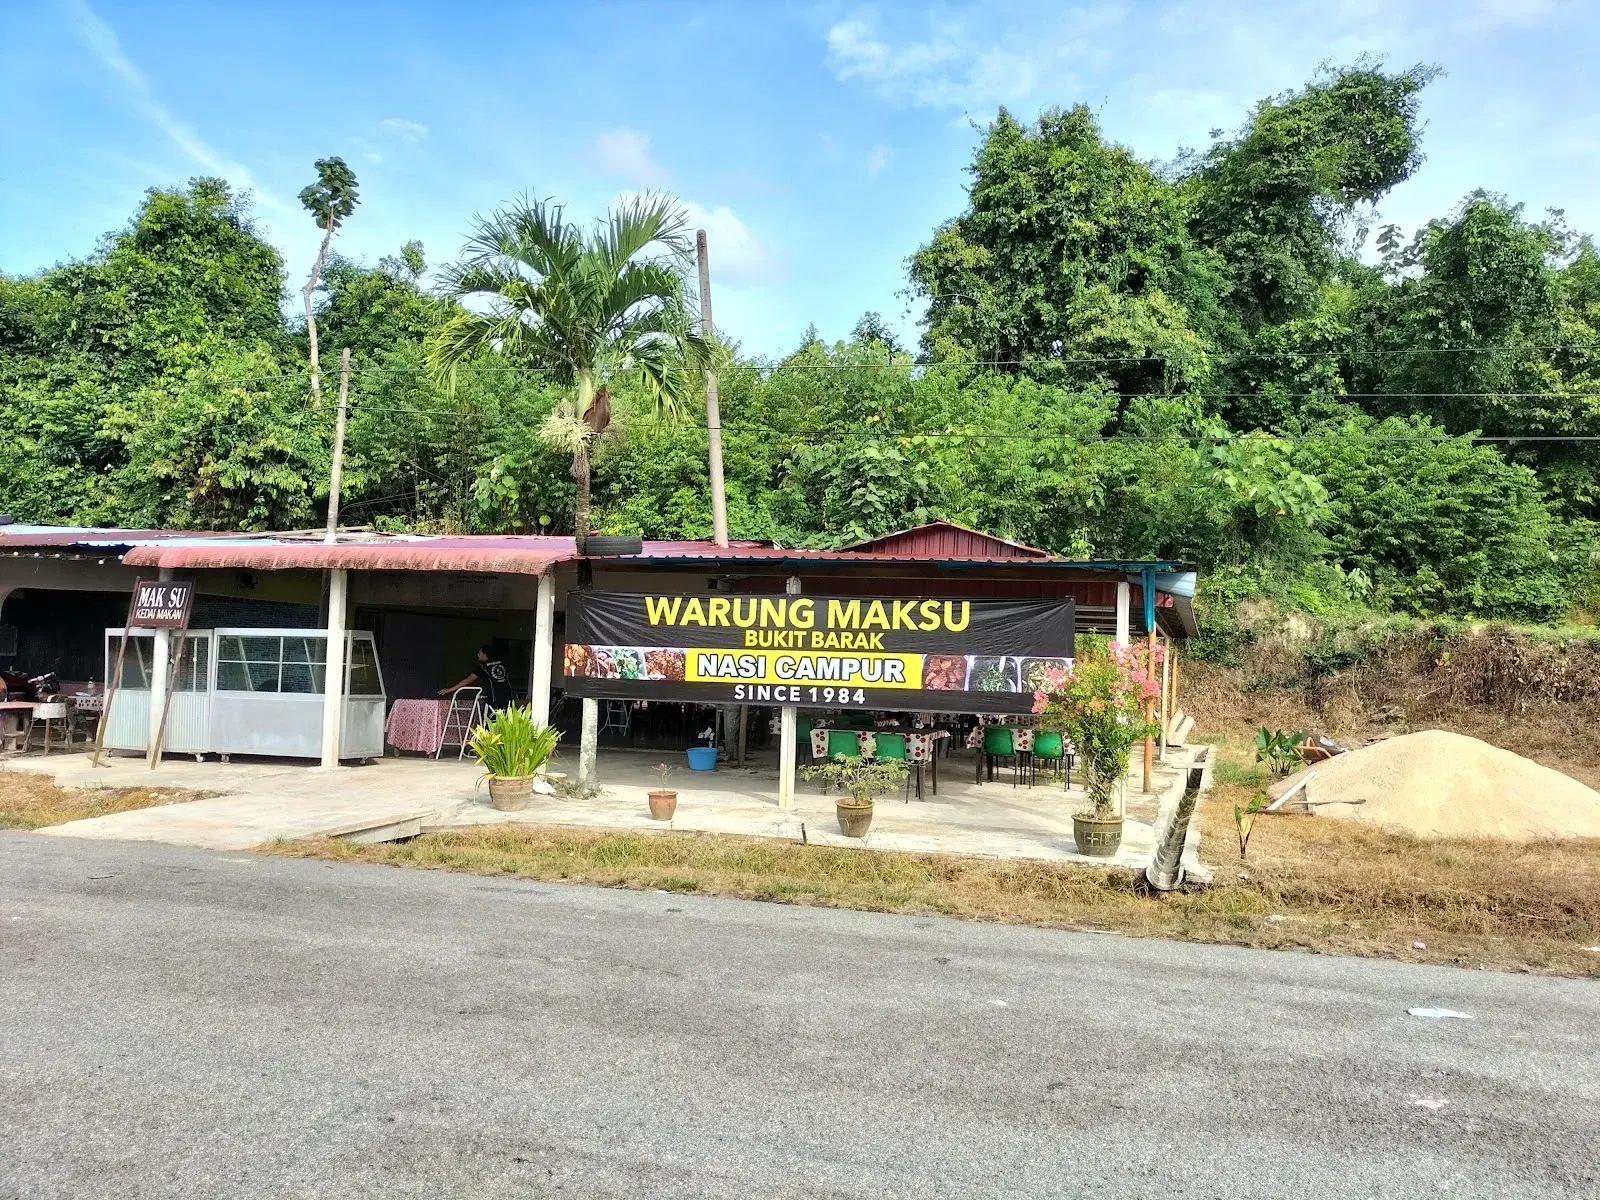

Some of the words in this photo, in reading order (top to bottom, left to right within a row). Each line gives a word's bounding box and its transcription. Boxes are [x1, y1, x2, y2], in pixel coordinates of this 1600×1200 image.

[138, 587, 166, 607] MAK
[168, 587, 187, 608] SU
[135, 608, 156, 619] KEDAI
[156, 609, 182, 620] MAKAN
[645, 597, 815, 628] WARUNG
[827, 599, 970, 631] MAKSU
[745, 630, 807, 648] BUKIT
[811, 632, 885, 649] BARAK
[698, 654, 766, 679] NASI
[775, 656, 906, 683] CAMPUR
[734, 685, 800, 702] SINCE
[808, 687, 866, 704] 1984
